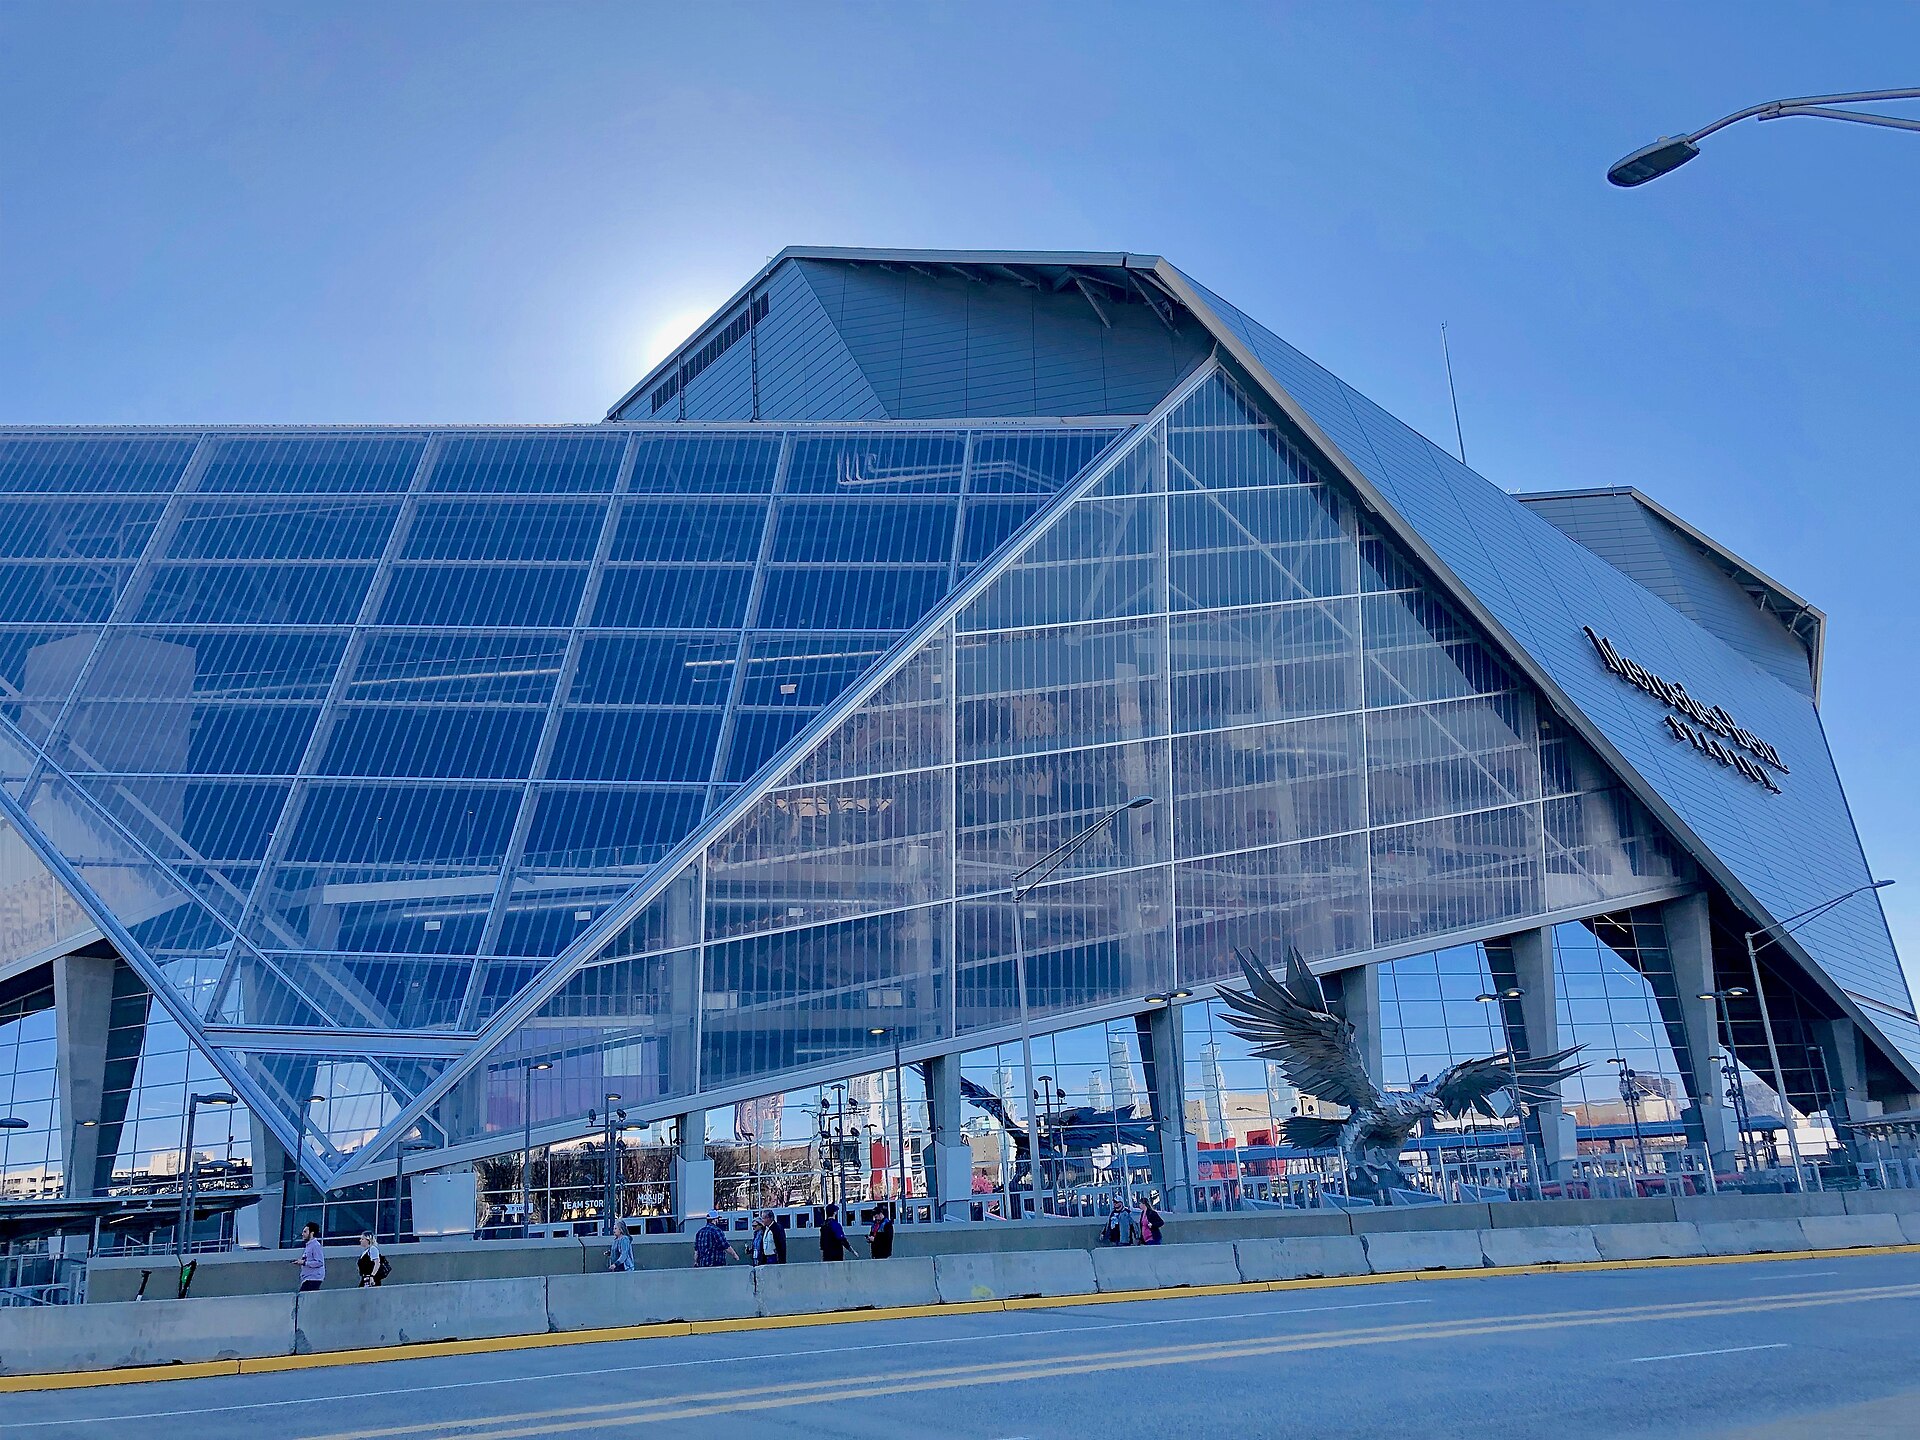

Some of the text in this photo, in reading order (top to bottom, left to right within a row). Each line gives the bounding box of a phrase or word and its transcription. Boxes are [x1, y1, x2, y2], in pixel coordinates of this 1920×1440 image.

[1664, 713, 1783, 795] STADIUM
[562, 1199, 604, 1210] TEAM STOR
